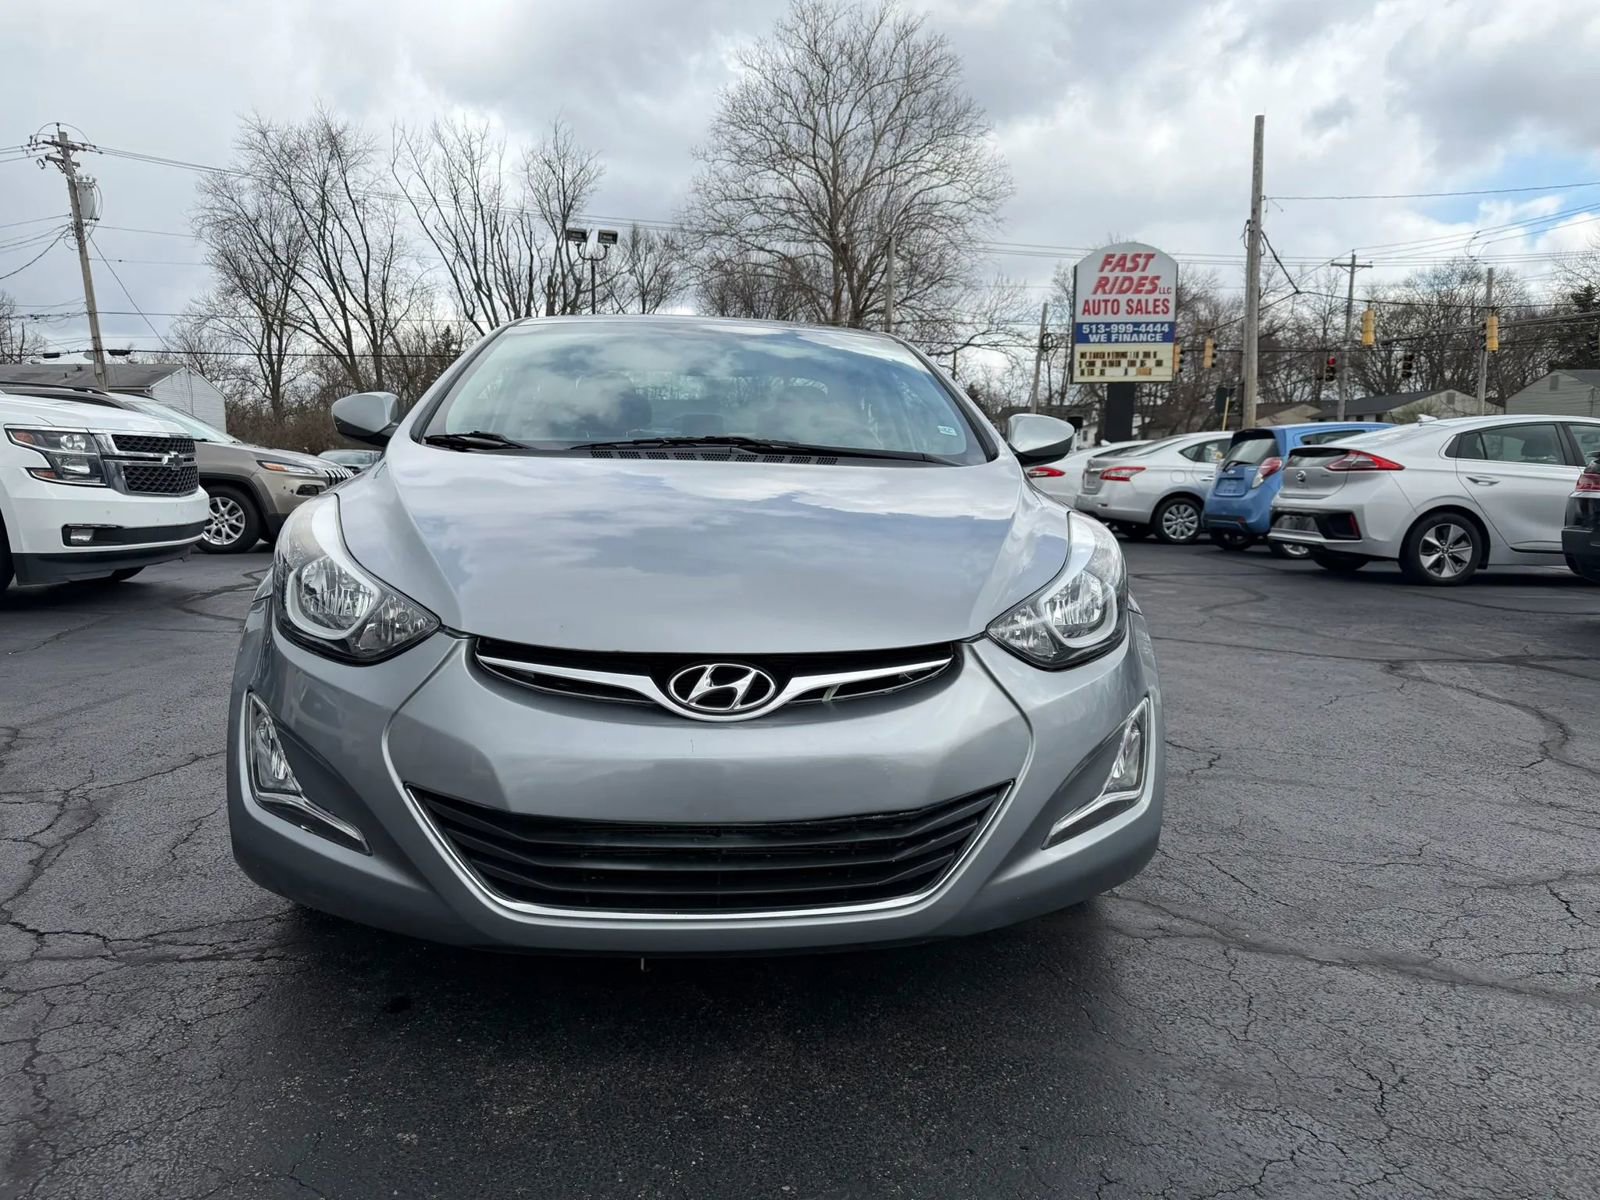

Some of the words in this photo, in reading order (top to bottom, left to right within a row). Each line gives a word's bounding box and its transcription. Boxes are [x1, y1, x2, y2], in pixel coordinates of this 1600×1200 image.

[1098, 253, 1156, 273] FAST
[1091, 275, 1162, 295] RIDES
[1158, 286, 1172, 295] LLC
[1082, 298, 1121, 316] AUTO
[1125, 298, 1170, 315] SALES
[1082, 323, 1169, 334] 513-999-4444
[1088, 333, 1108, 343] WE
[1111, 332, 1164, 343] FINANCE
